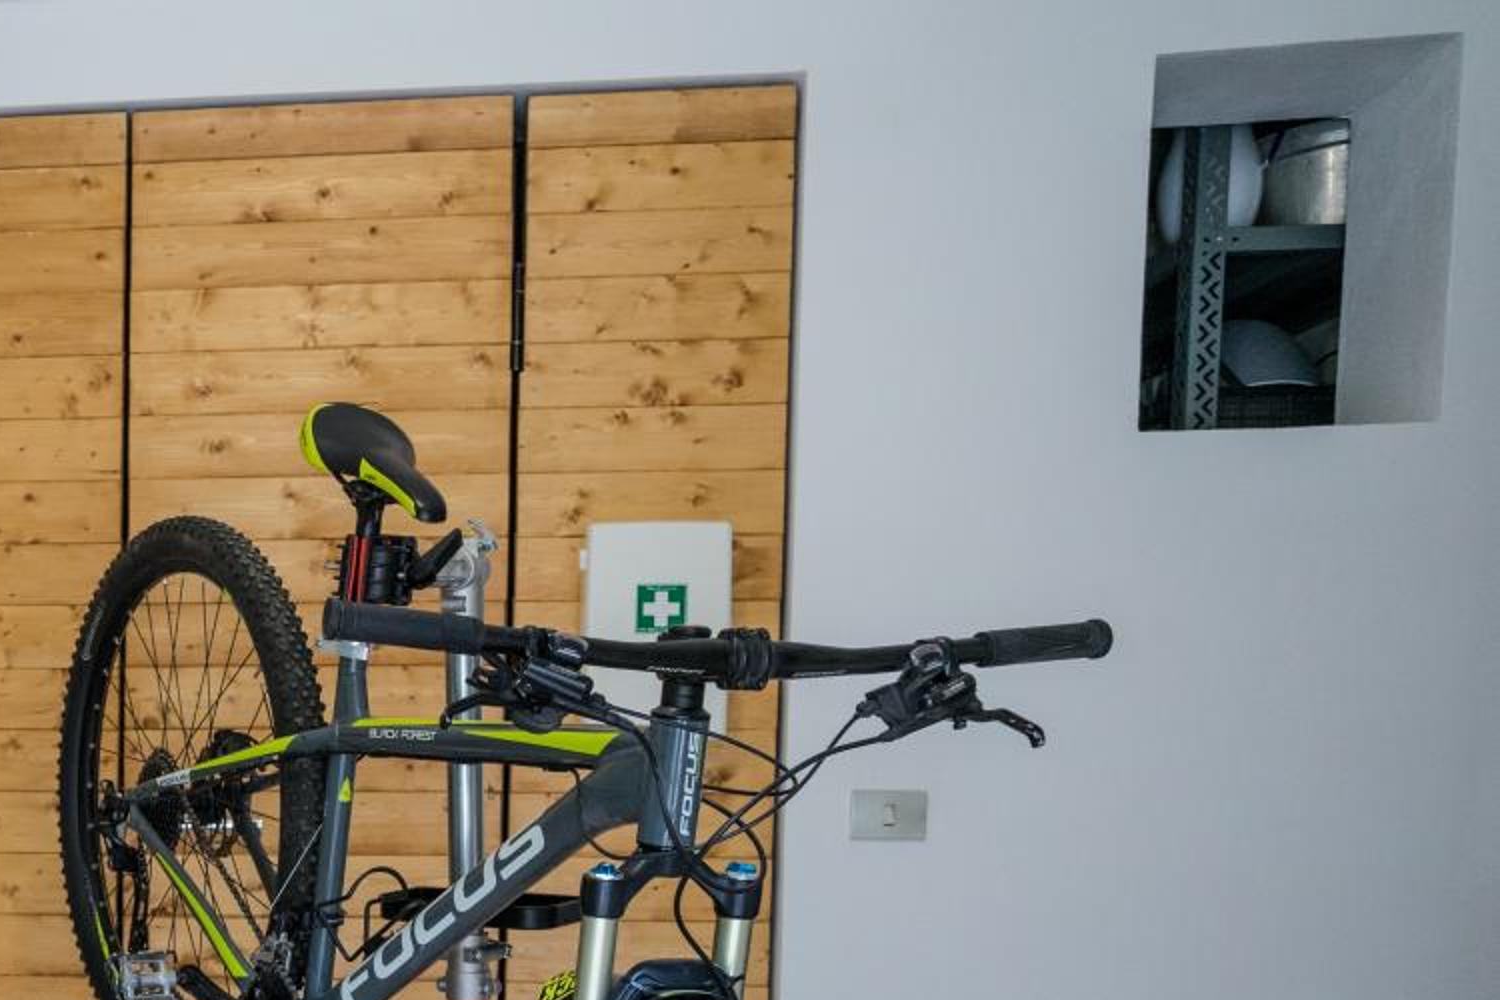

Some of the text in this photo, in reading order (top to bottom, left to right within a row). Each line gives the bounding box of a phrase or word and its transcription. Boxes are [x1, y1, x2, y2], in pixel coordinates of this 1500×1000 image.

[369, 728, 437, 741] BLACK FOREST
[679, 731, 701, 837] FOCUS
